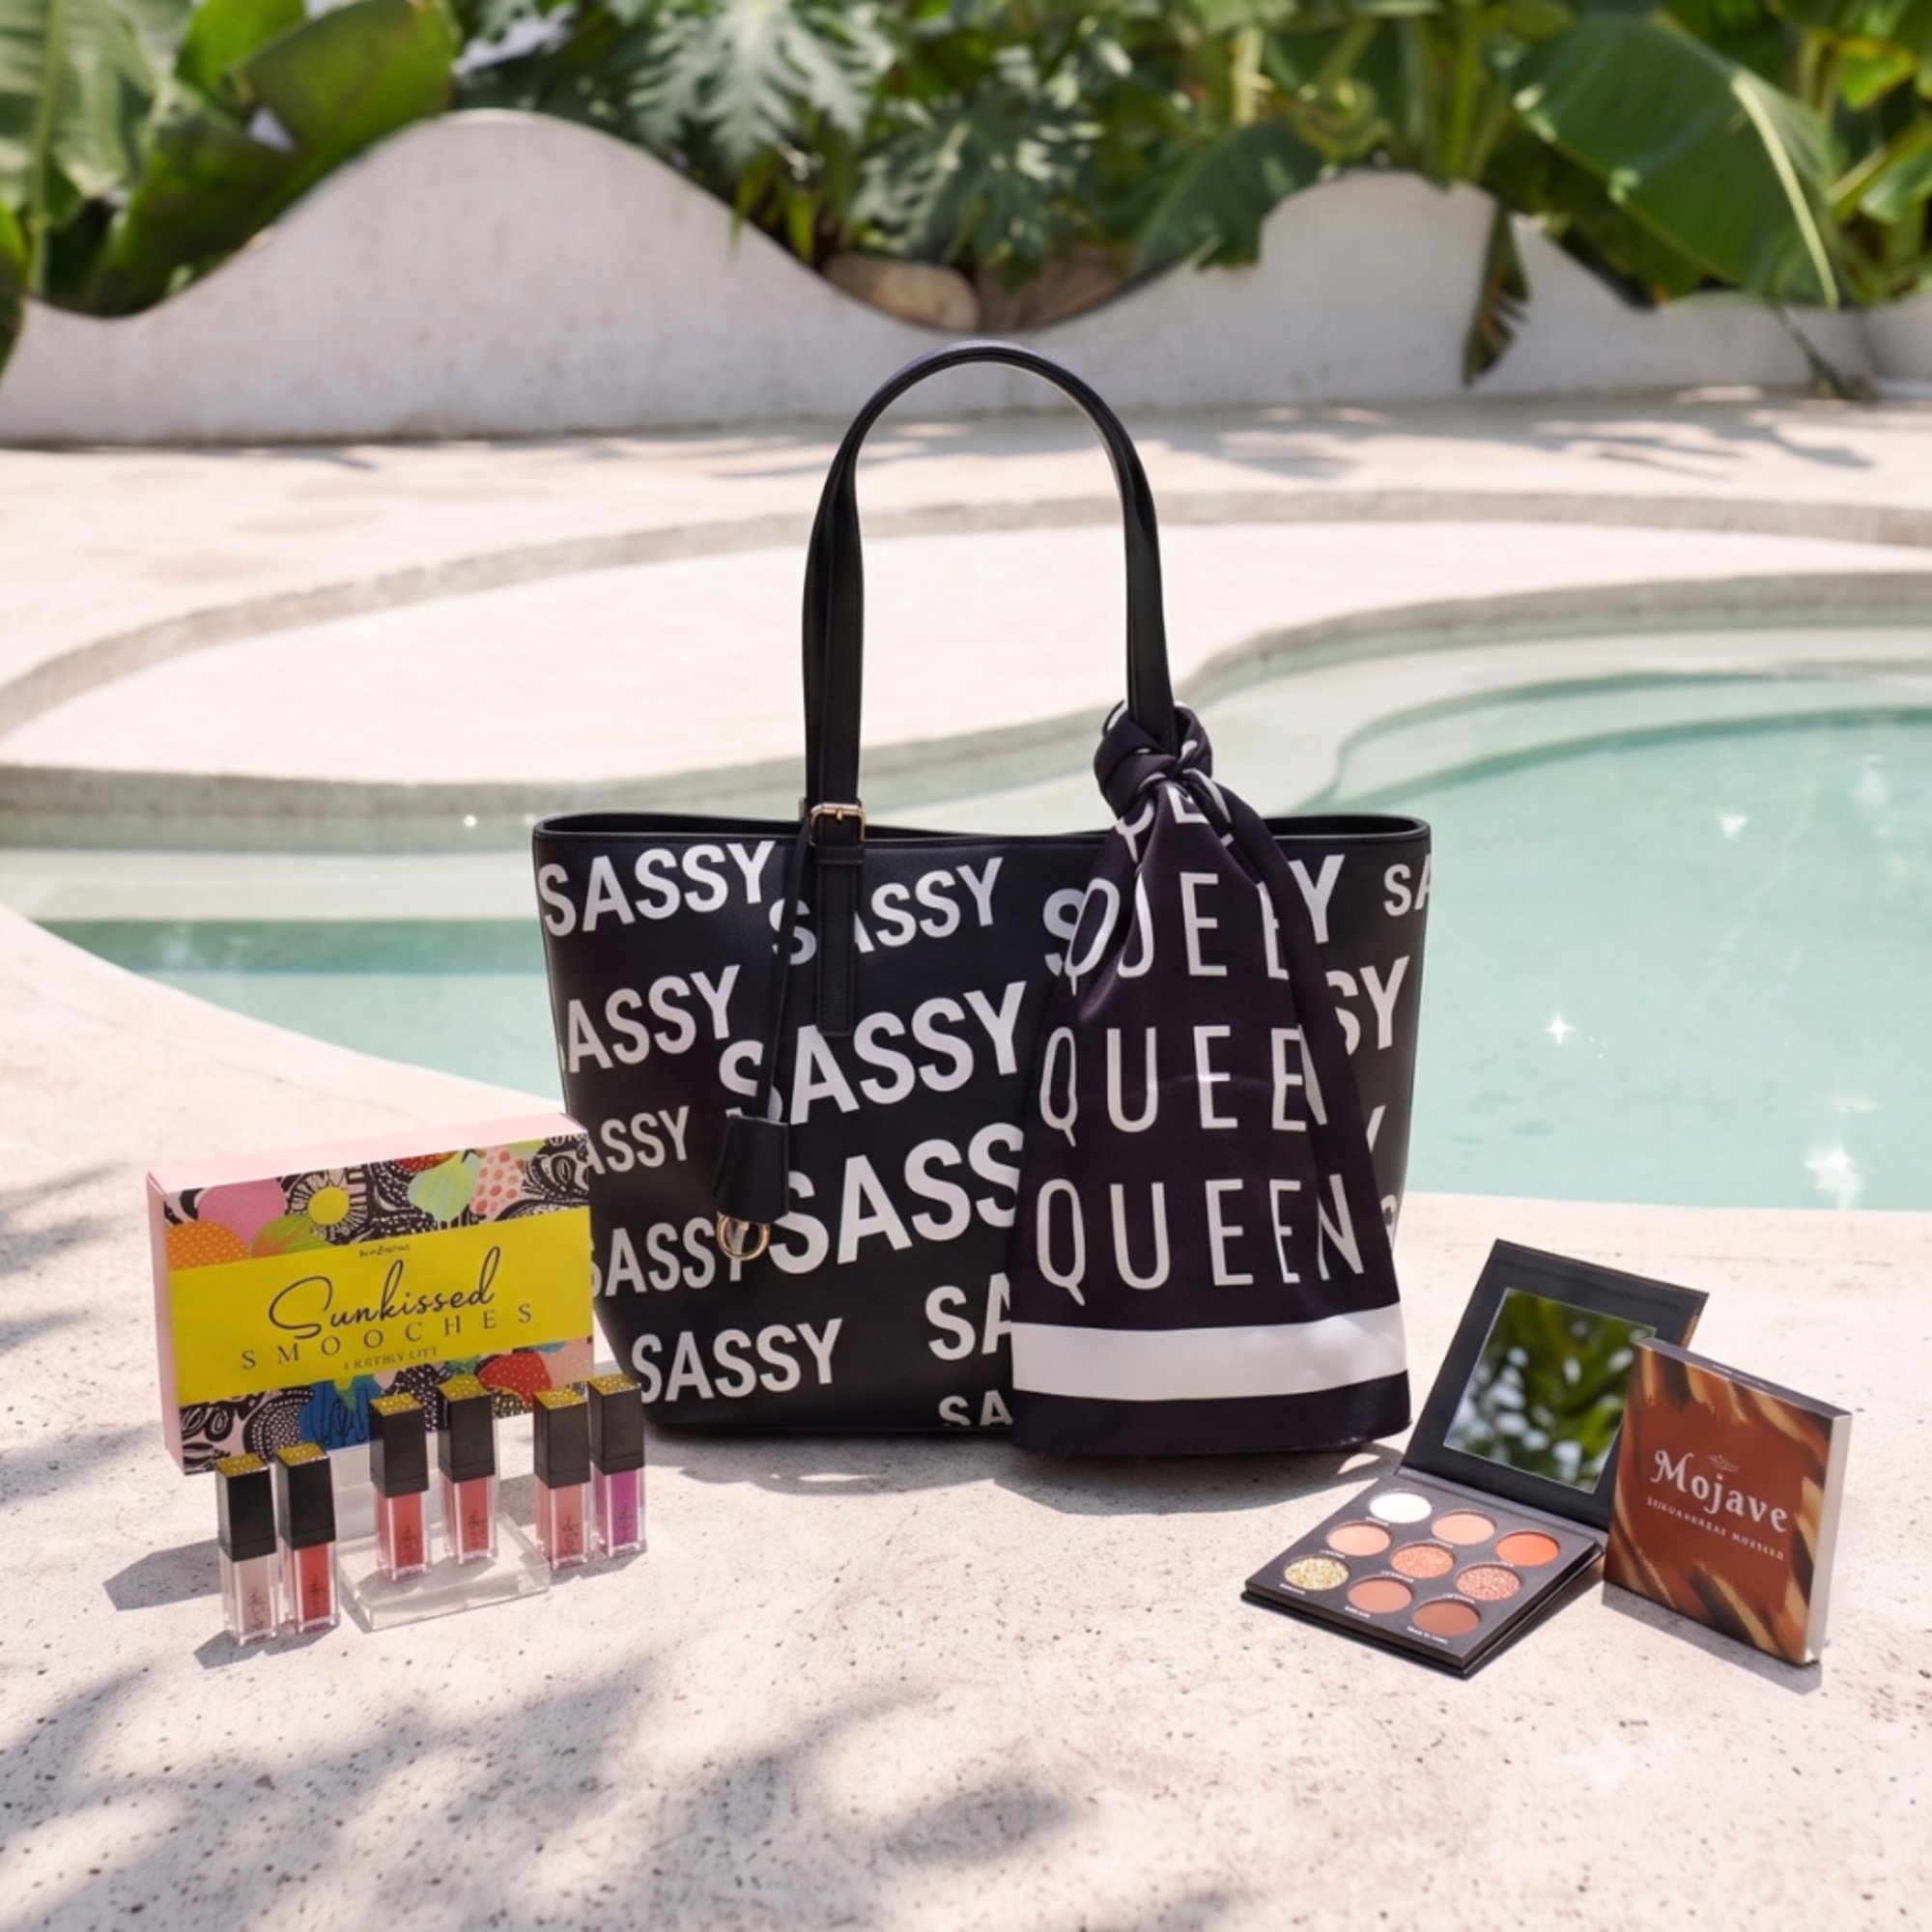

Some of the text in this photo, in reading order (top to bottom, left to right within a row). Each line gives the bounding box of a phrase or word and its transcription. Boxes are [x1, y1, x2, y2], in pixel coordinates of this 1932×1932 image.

[538, 840, 776, 937] SASSY
[559, 965, 742, 1074] ASSY
[768, 1122, 1025, 1274] SASS
[1036, 1173, 1365, 1307] QUEEN
[242, 1302, 532, 1371] SMOOCHES
[268, 1245, 501, 1341] Sunkissed
[631, 1318, 843, 1405] SASSY
[1650, 1449, 1788, 1533] Mojave
